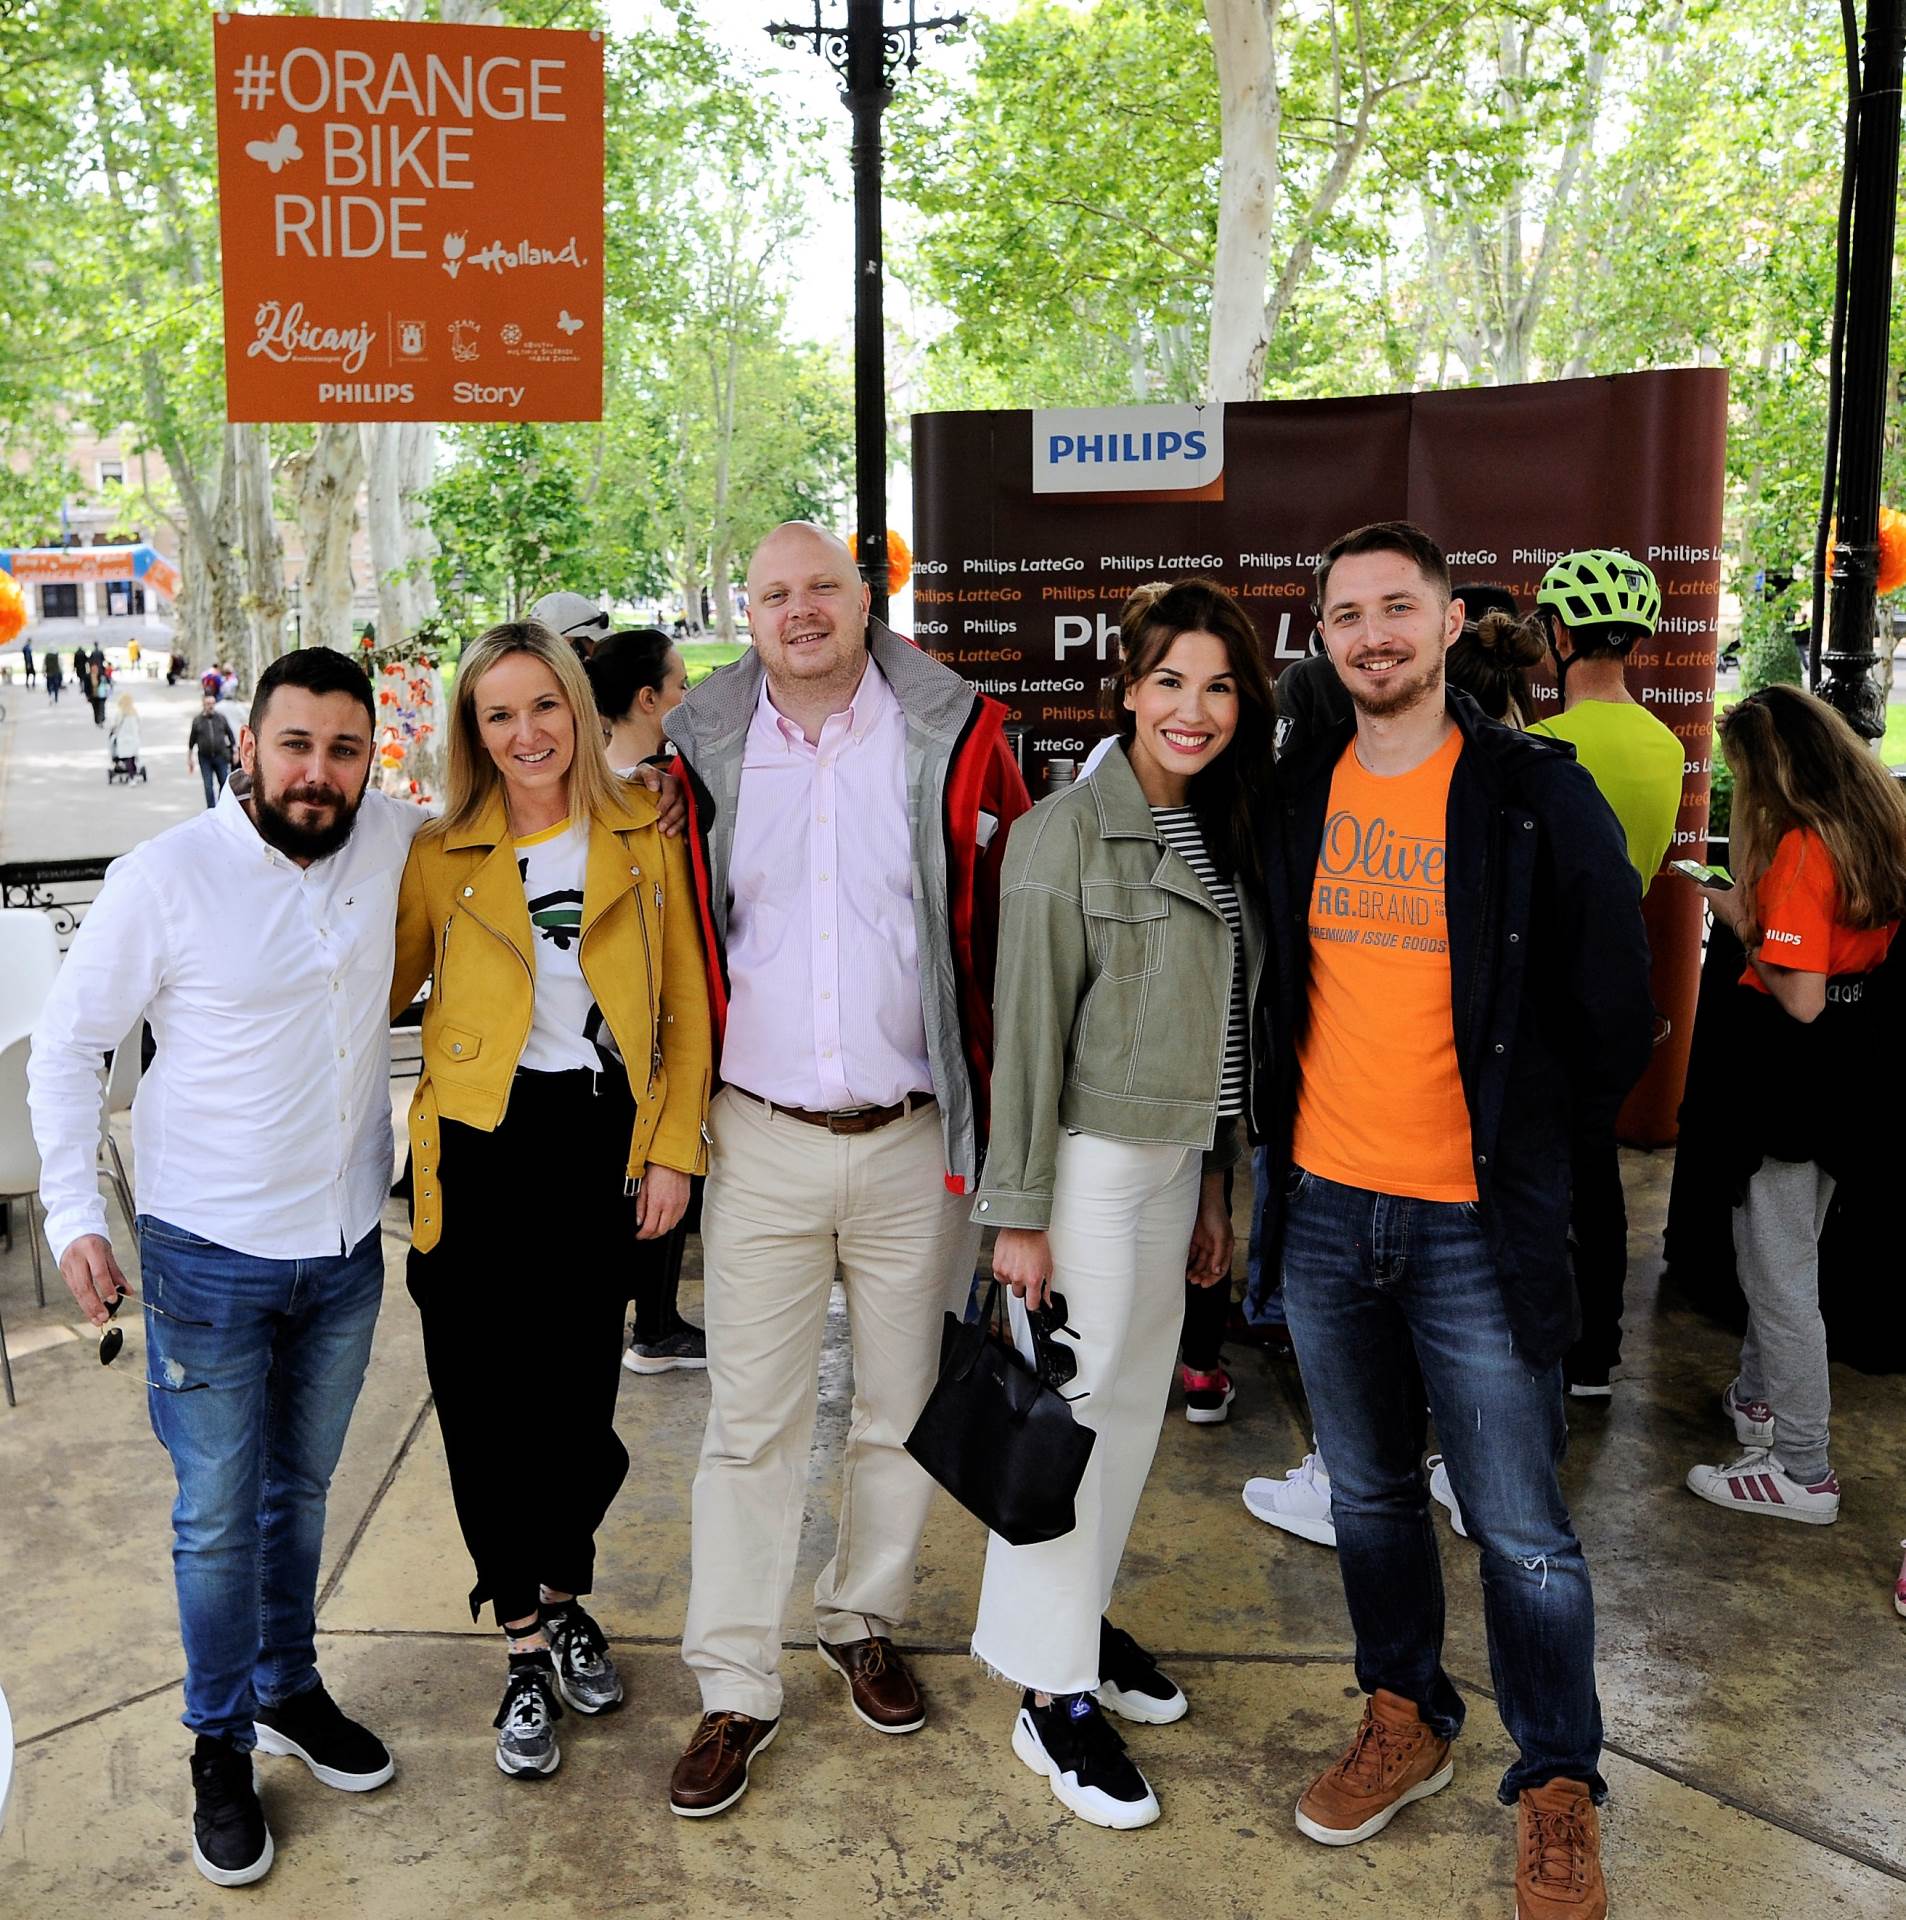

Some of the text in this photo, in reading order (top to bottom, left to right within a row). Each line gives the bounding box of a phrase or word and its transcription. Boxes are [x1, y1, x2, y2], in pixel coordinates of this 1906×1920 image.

[233, 47, 566, 122] #ORANGE
[324, 123, 474, 189] BIKE
[274, 194, 427, 259] RIDE
[319, 383, 415, 403] PHILIPS
[453, 382, 525, 408] Story
[1049, 430, 1207, 464] PHILIPS
[912, 561, 948, 574] tteGo
[963, 559, 1017, 575] Philips
[1020, 557, 1085, 573] LatteGo
[1100, 556, 1154, 571] Philips
[1158, 554, 1223, 569] LatteGo
[1240, 553, 1292, 569] Philips
[1445, 550, 1497, 564] atteGo
[1648, 545, 1710, 564] Philips
[958, 588, 1022, 602] LatteGo
[1042, 586, 1095, 602] Philips
[1243, 583, 1306, 597] LatteGo
[913, 620, 1017, 635] tteGo Philips
[1658, 617, 1706, 635] hilips
[959, 648, 1022, 662] LatteGo
[1021, 678, 1085, 692] LatteGo
[1642, 687, 1704, 707] Philips
[1042, 707, 1095, 723] Philips
[1361, 931, 1399, 948] ISSUE
[1402, 935, 1448, 953] GOODS
